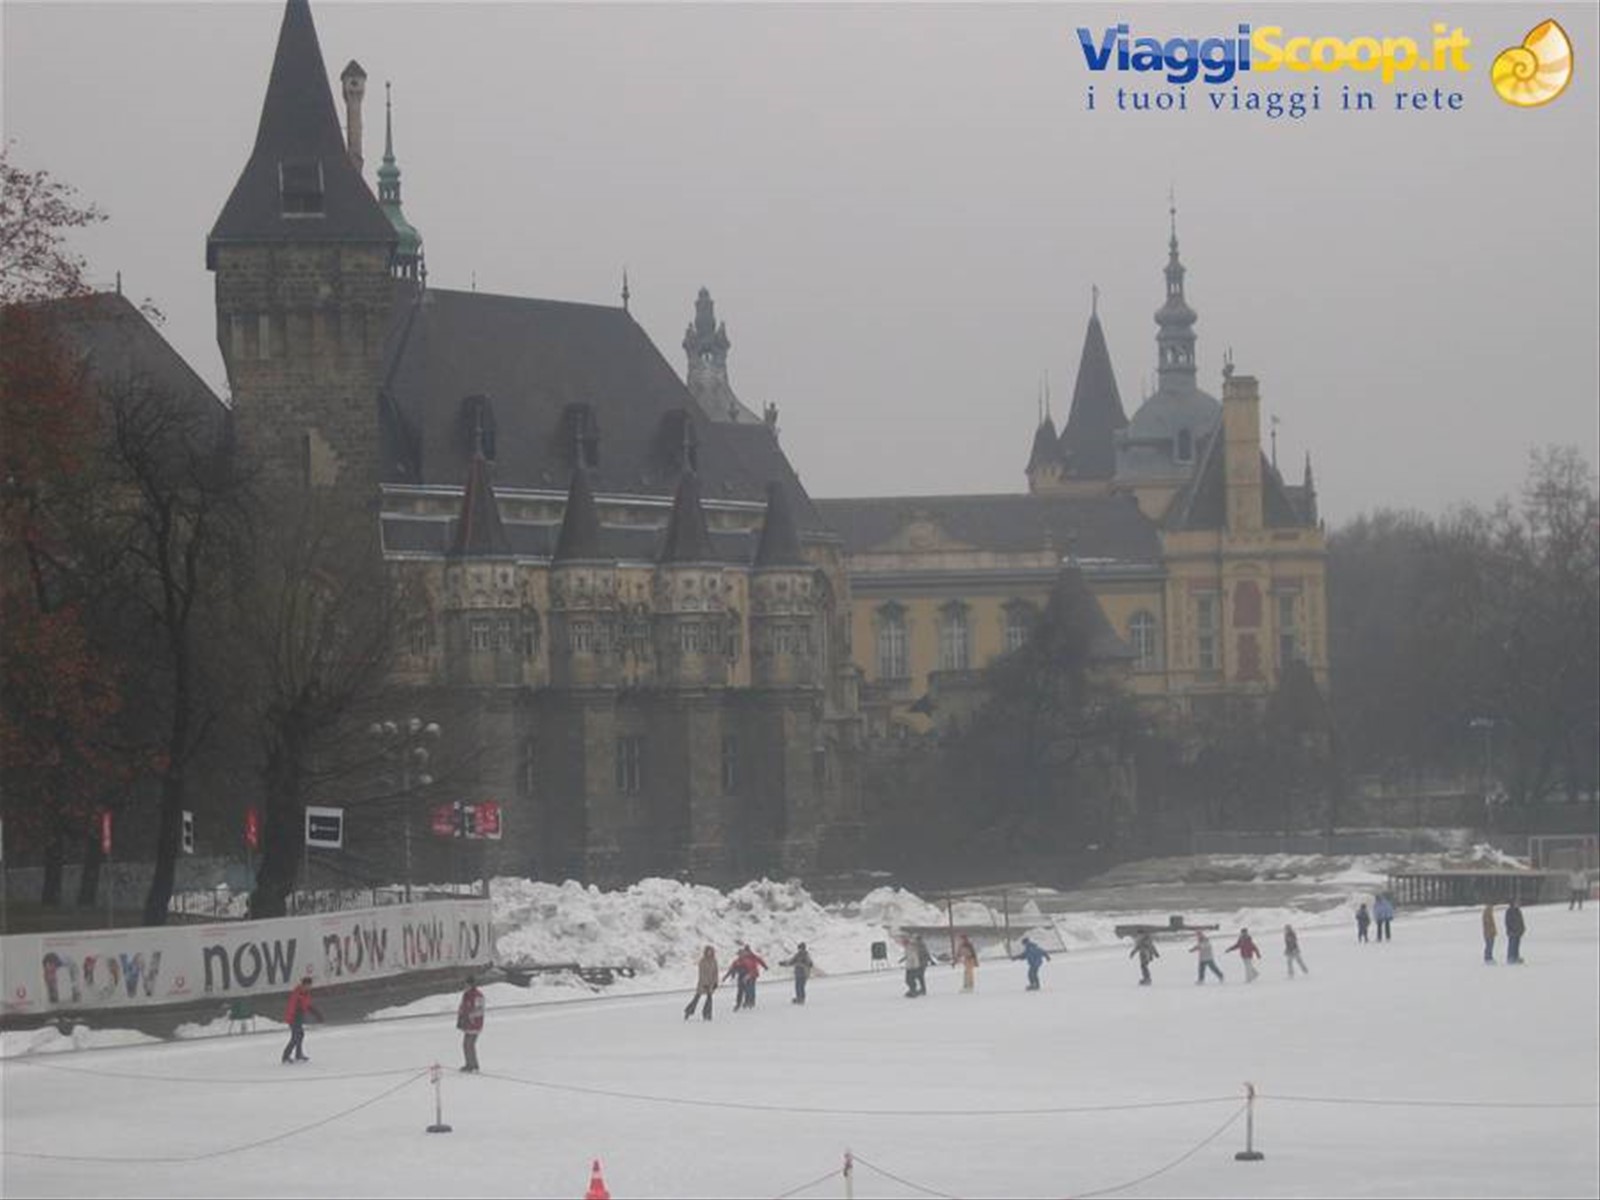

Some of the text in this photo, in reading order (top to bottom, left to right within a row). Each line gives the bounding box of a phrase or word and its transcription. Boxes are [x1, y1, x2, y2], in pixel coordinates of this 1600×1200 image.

[203, 938, 297, 991] now
[323, 924, 387, 976] now
[42, 952, 161, 1002] now
